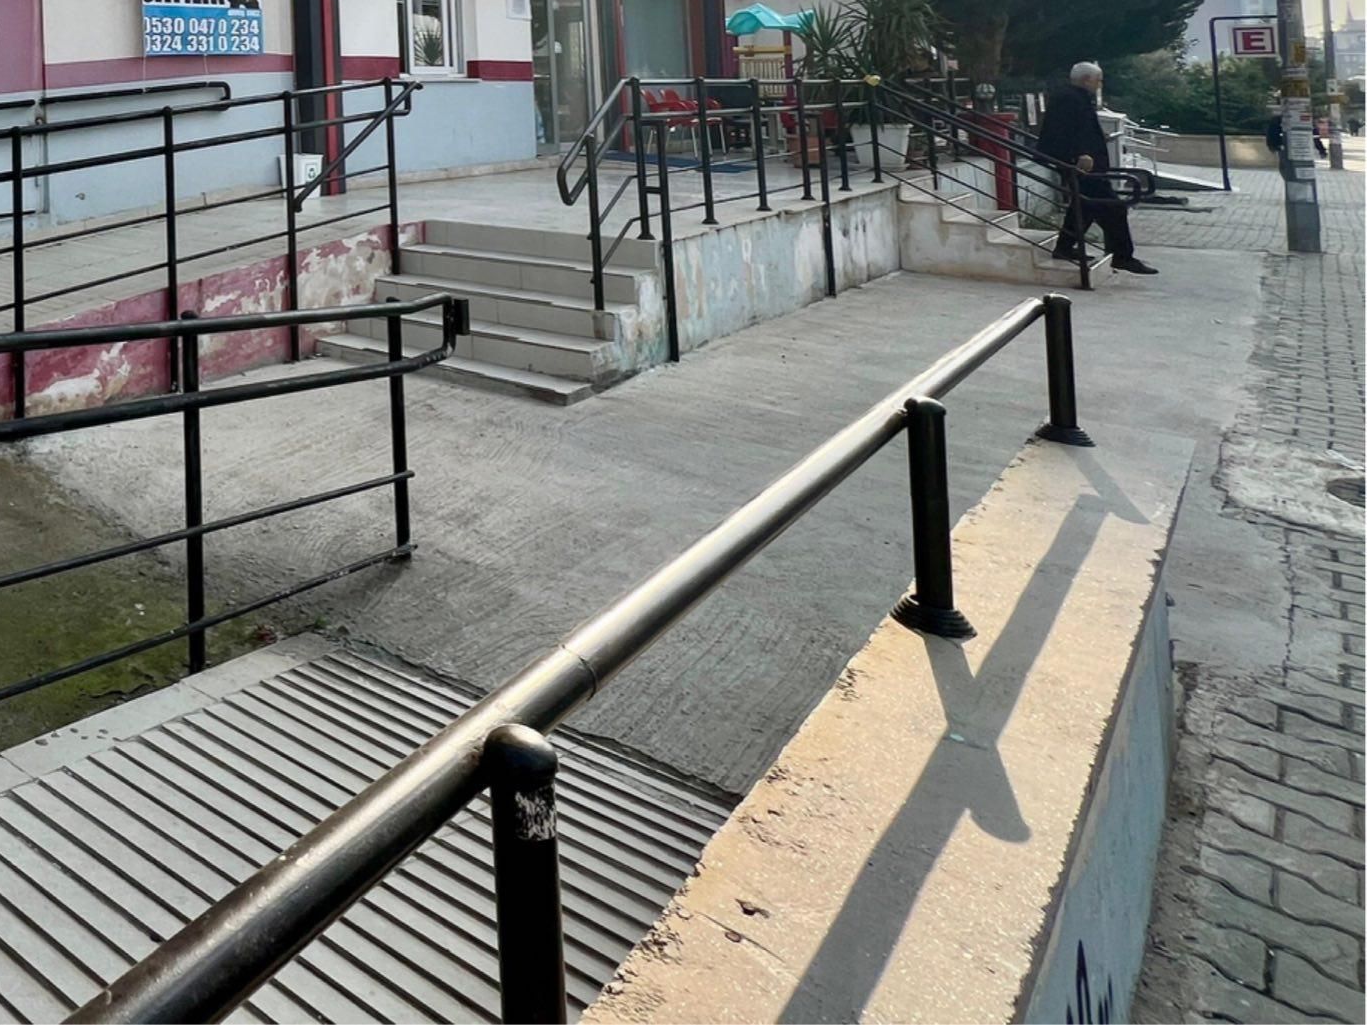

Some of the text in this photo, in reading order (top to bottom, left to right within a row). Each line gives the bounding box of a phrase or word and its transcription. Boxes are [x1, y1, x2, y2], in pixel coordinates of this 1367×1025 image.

[230, 19, 260, 34] 234
[231, 36, 260, 52] 234
[1242, 31, 1266, 51] E
